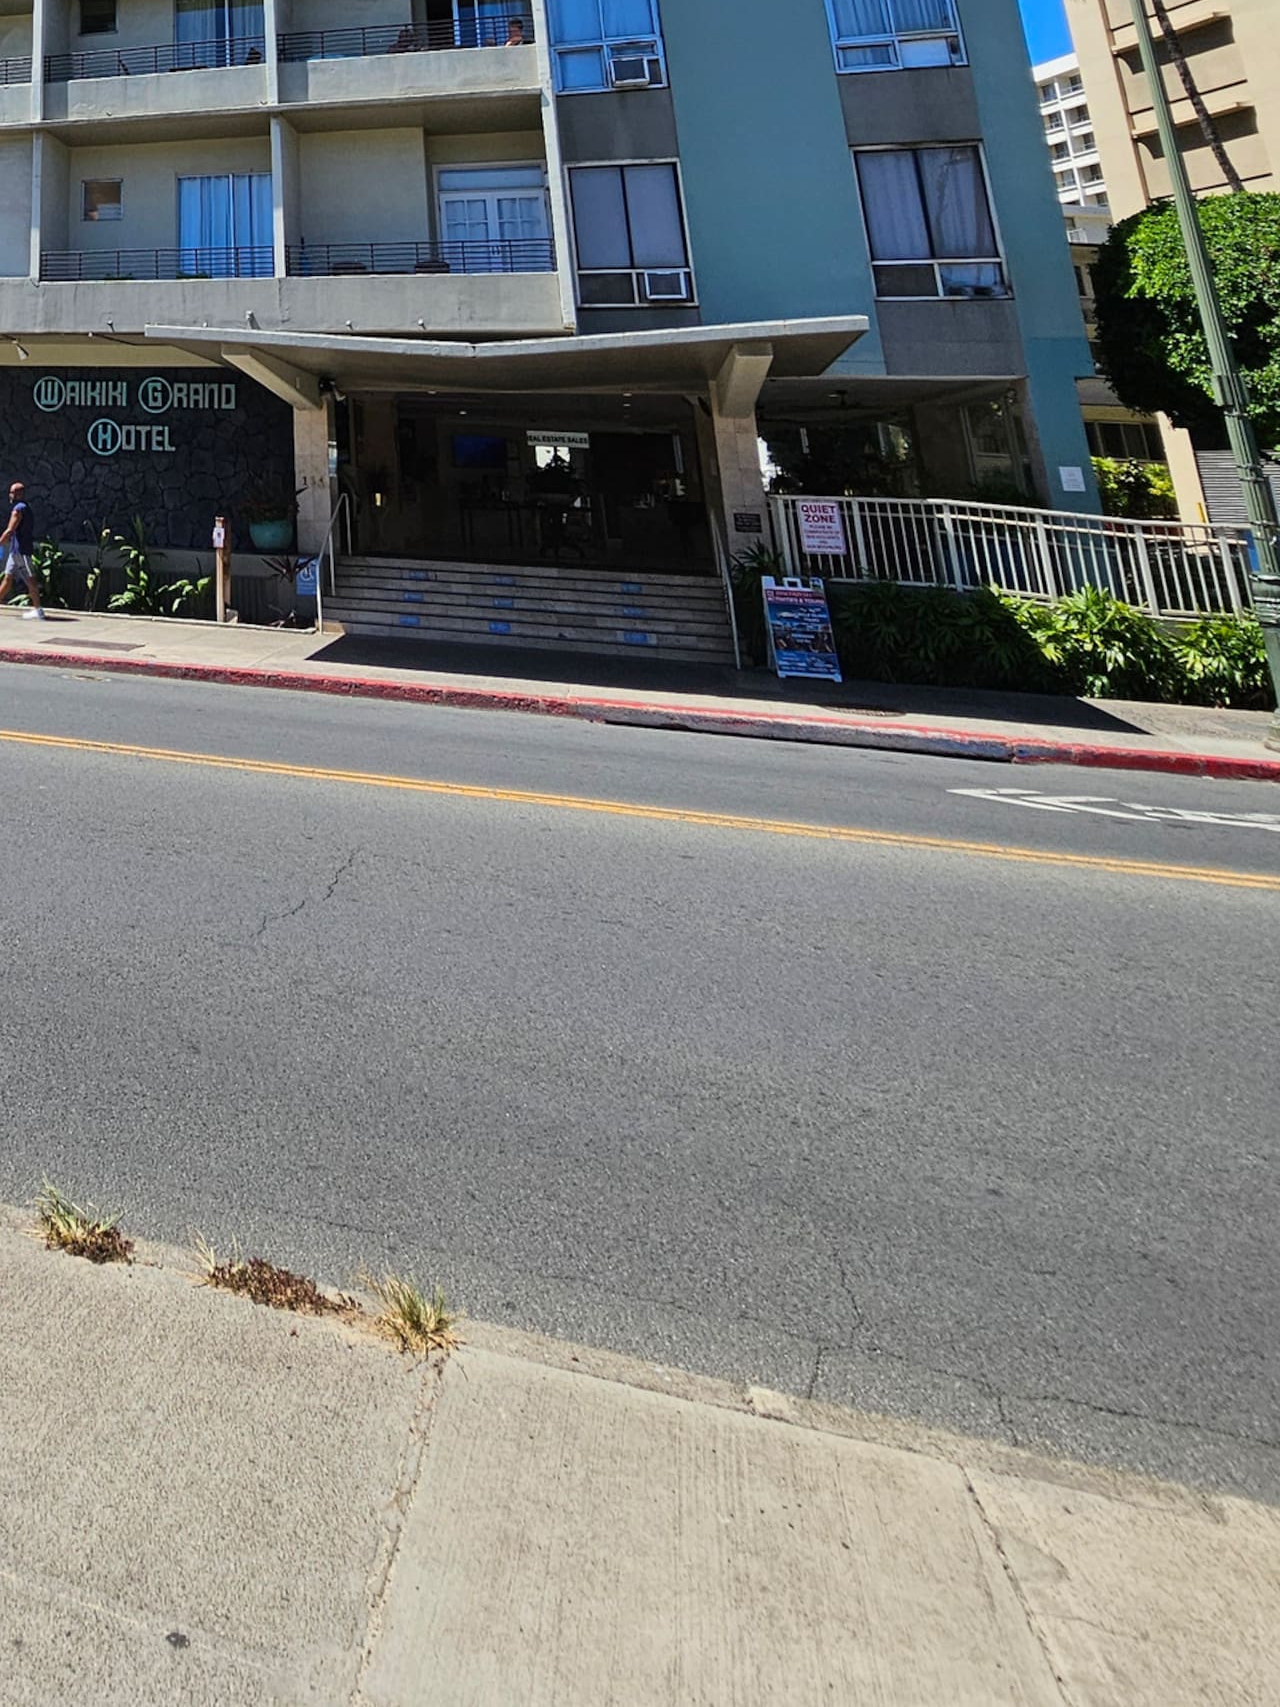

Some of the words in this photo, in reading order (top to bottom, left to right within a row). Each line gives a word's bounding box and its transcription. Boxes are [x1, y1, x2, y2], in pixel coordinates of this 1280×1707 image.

[36, 379, 127, 409] WAIKIKI
[142, 379, 236, 411] GRAND
[92, 422, 176, 453] HOTEL
[801, 504, 836, 514] QUIET
[804, 514, 837, 524] ZONE
